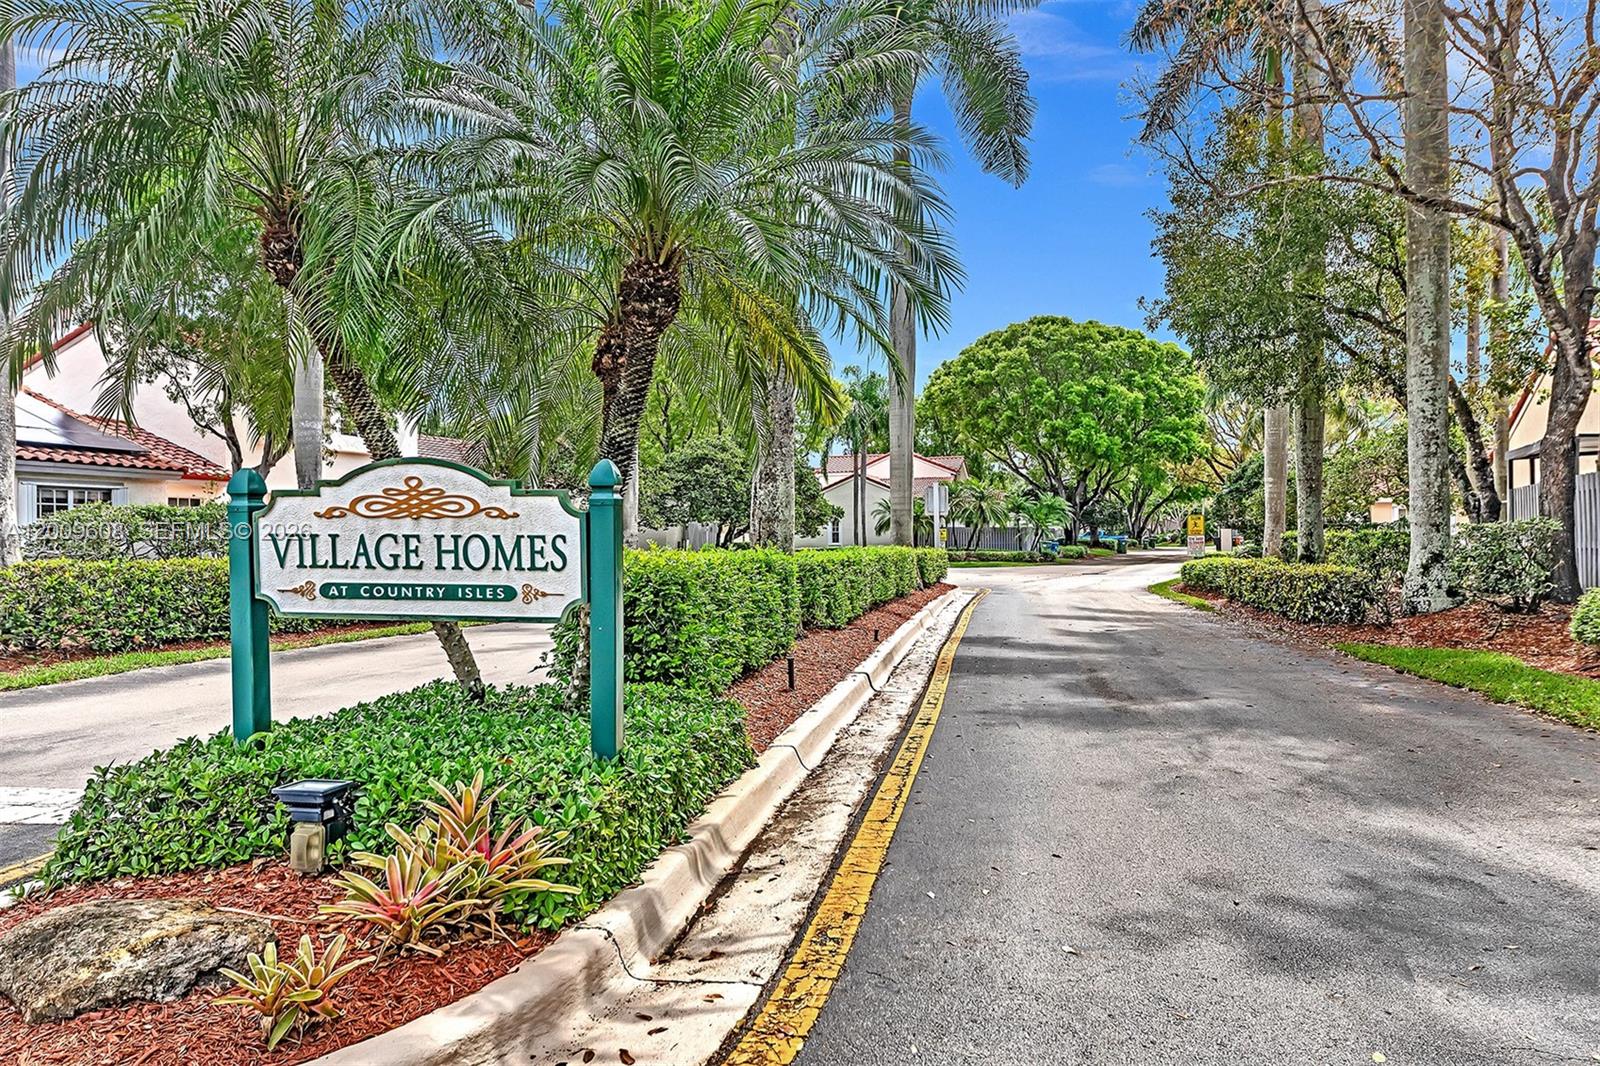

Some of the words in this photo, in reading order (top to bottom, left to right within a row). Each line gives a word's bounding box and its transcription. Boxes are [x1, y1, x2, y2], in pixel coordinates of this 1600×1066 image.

[270, 533, 424, 571] VILLAGE
[434, 533, 568, 573] HOMES
[329, 584, 348, 597] AT
[360, 584, 445, 599] COUNTRY
[457, 585, 505, 600] ISLES
